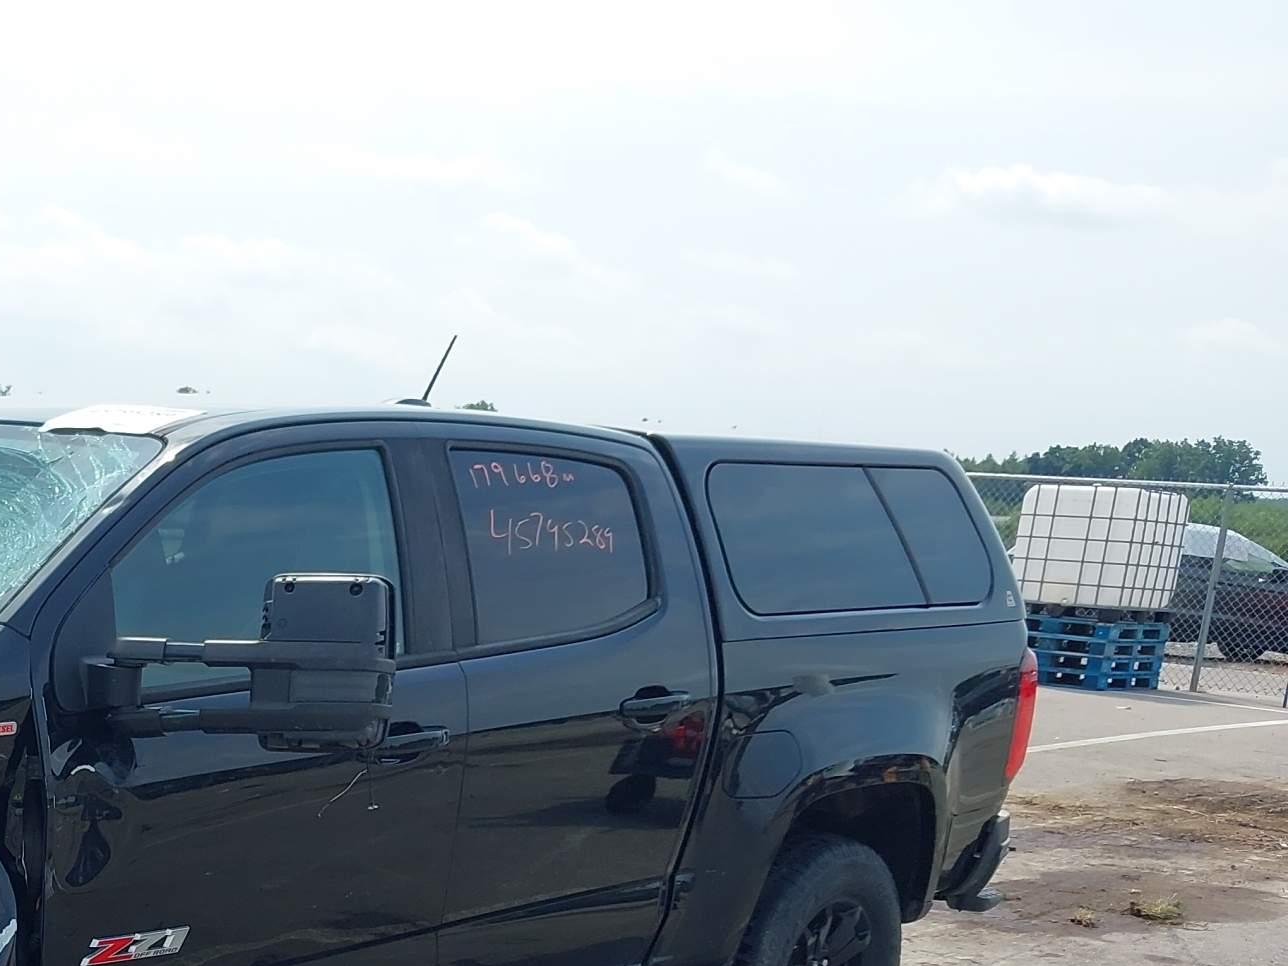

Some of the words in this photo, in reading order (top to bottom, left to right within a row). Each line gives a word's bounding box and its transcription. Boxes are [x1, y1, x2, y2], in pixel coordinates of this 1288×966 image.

[468, 461, 559, 489] 179668
[79, 926, 191, 966] Z71
[133, 950, 152, 959] OFF
[152, 947, 178, 957] ROAD
